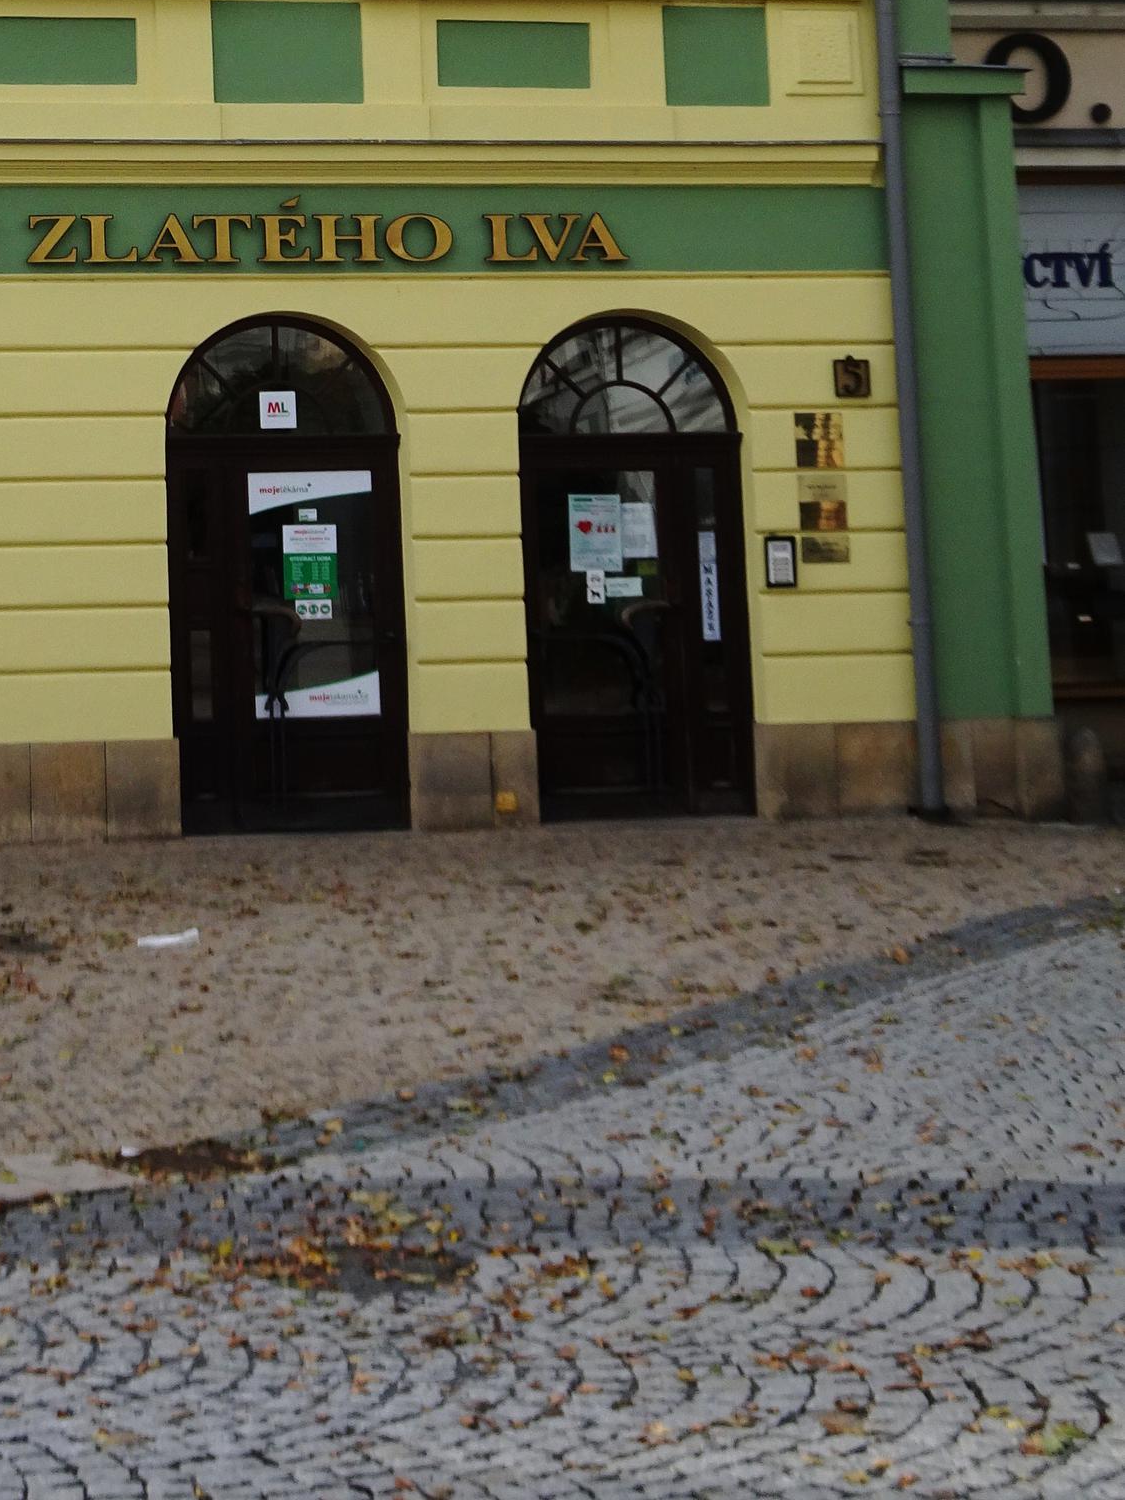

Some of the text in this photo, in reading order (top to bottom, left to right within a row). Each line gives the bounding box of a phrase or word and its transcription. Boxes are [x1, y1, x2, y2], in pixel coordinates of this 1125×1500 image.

[26, 194, 455, 264] ZLATÉHO
[482, 212, 630, 263] LVA
[267, 402, 289, 414] ML
